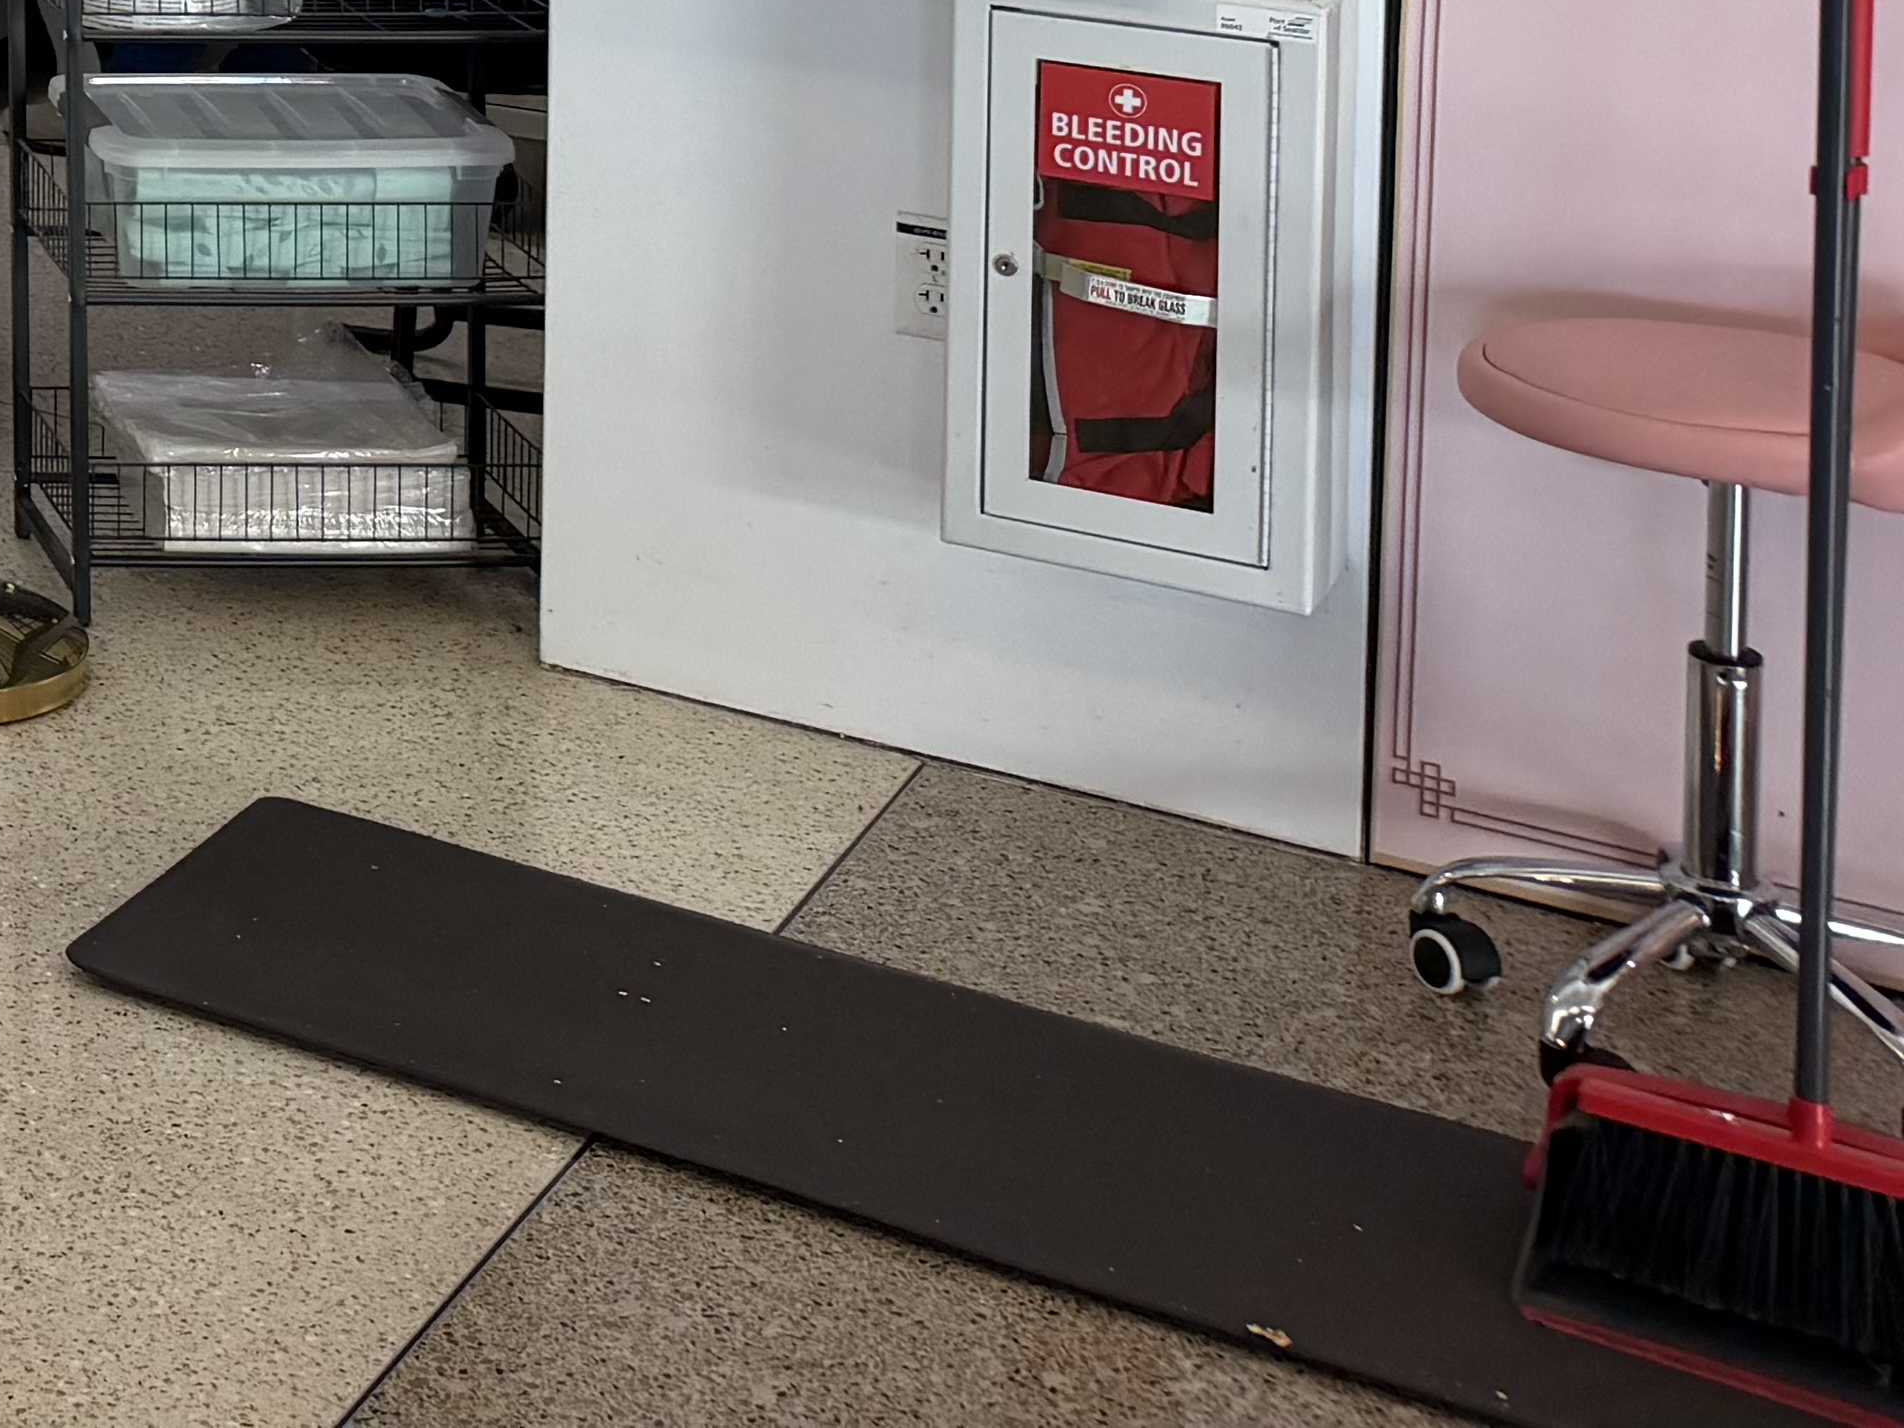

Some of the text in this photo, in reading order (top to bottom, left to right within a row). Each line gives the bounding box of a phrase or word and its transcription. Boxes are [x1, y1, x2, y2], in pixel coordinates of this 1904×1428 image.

[1050, 112, 1204, 161] BLEEDING
[1052, 145, 1200, 189] CONTROL
[1091, 285, 1112, 300] PULL
[1114, 290, 1125, 303] TO
[1128, 293, 1155, 311] BREAK
[1158, 298, 1186, 315] GLASS
